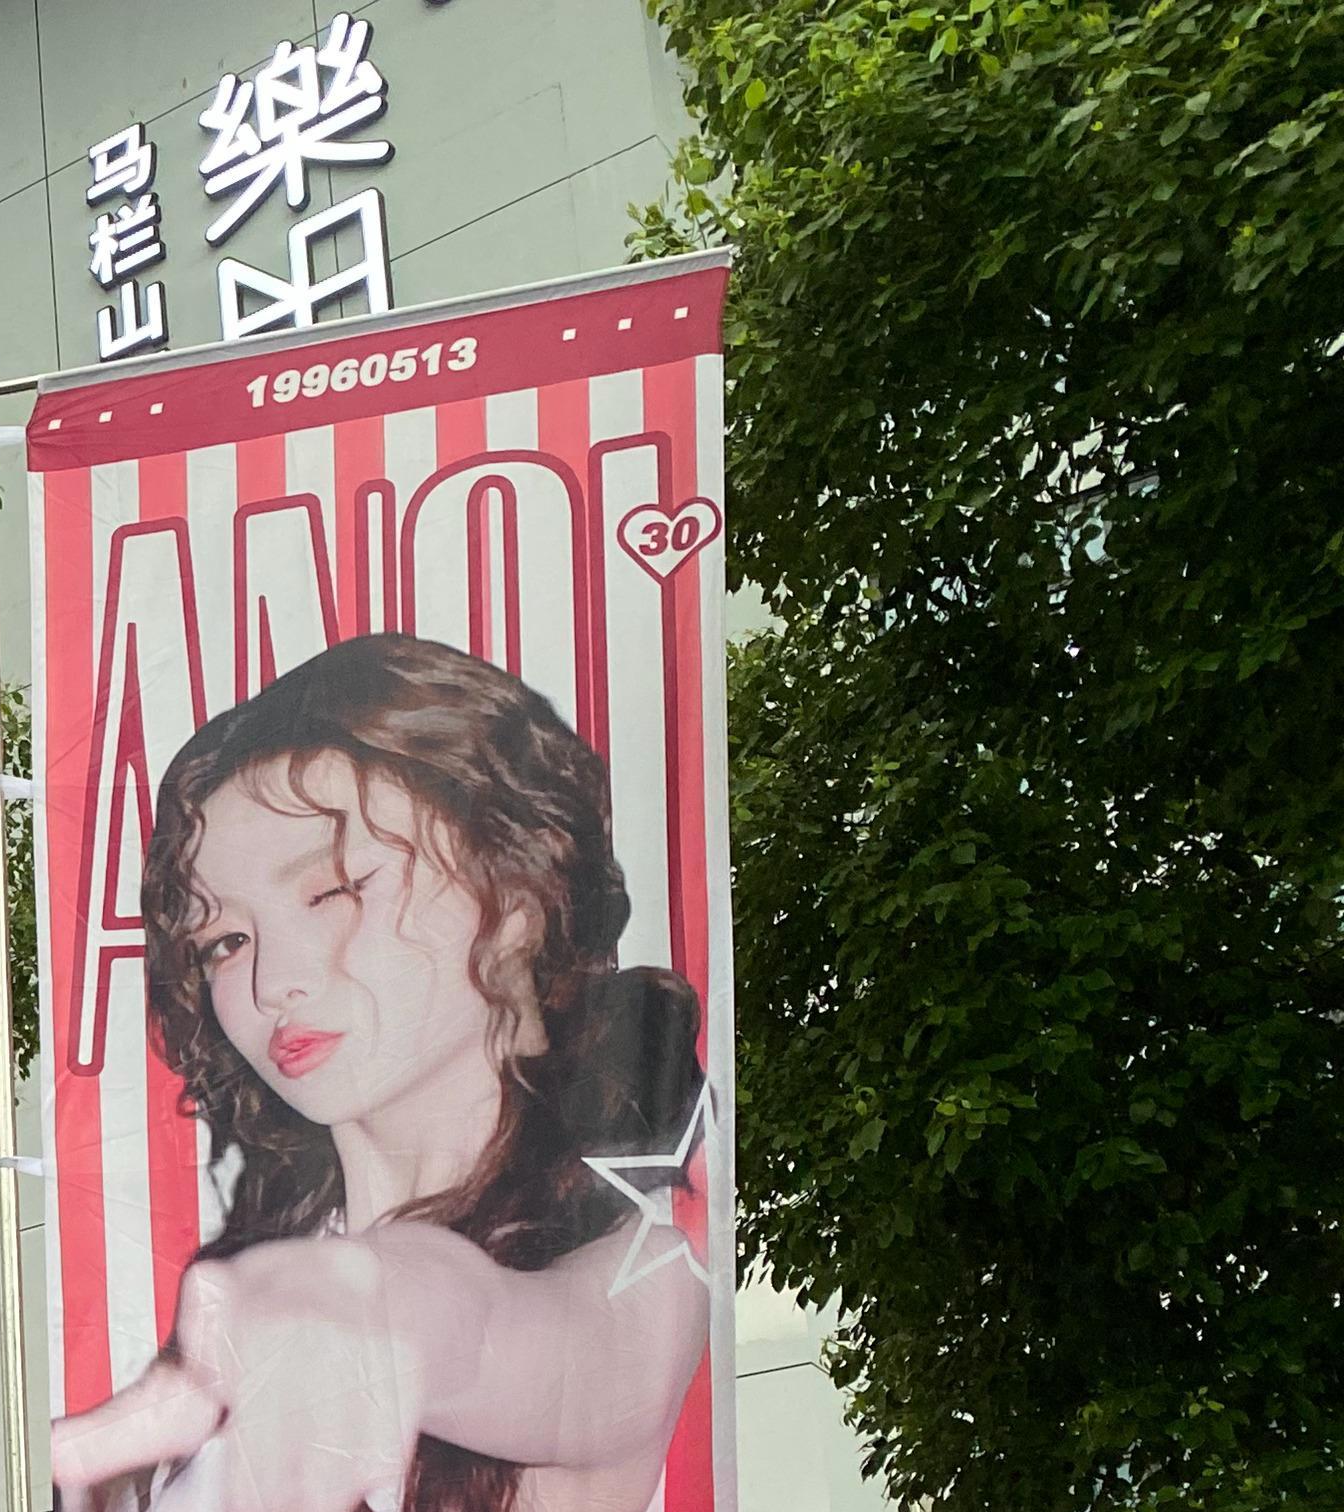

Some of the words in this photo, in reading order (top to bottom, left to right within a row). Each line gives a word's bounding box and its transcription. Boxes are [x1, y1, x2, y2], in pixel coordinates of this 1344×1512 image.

[85, 122, 169, 362] 马栏山
[246, 337, 478, 409] 19960513
[638, 518, 699, 555] 30
